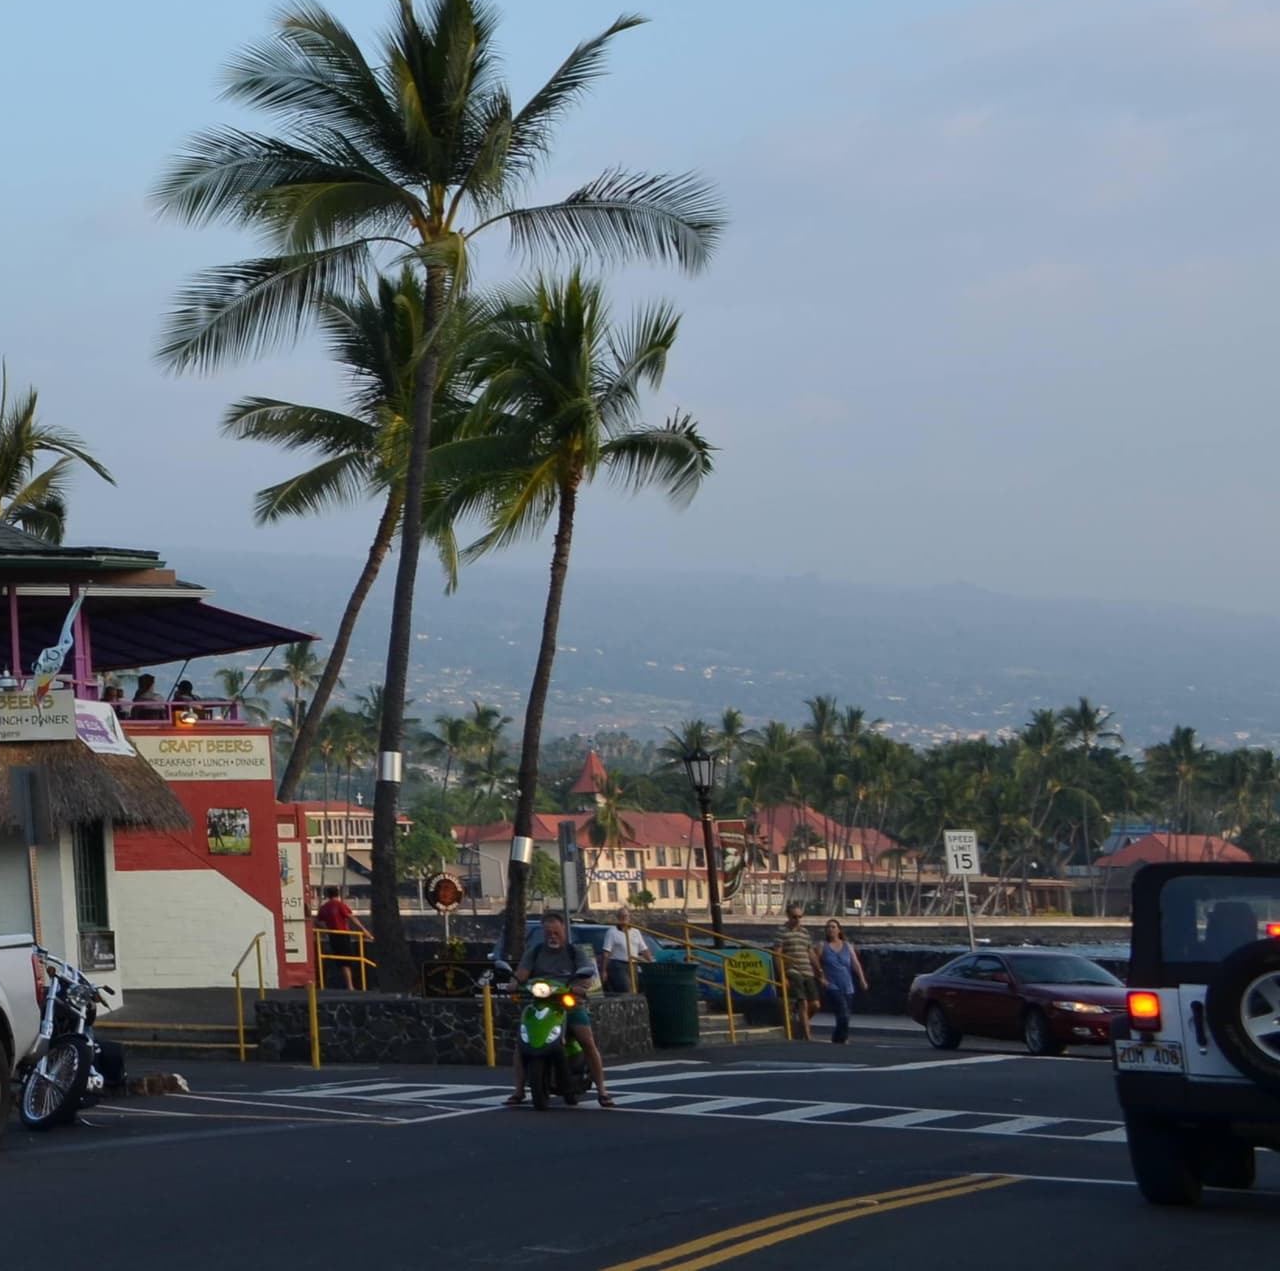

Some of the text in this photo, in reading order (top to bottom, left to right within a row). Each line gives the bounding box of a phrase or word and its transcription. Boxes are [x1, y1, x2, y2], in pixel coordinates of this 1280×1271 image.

[158, 739, 253, 753] CRAFT BEERS
[203, 758, 230, 767] LUNCH
[953, 854, 973, 869] 15
